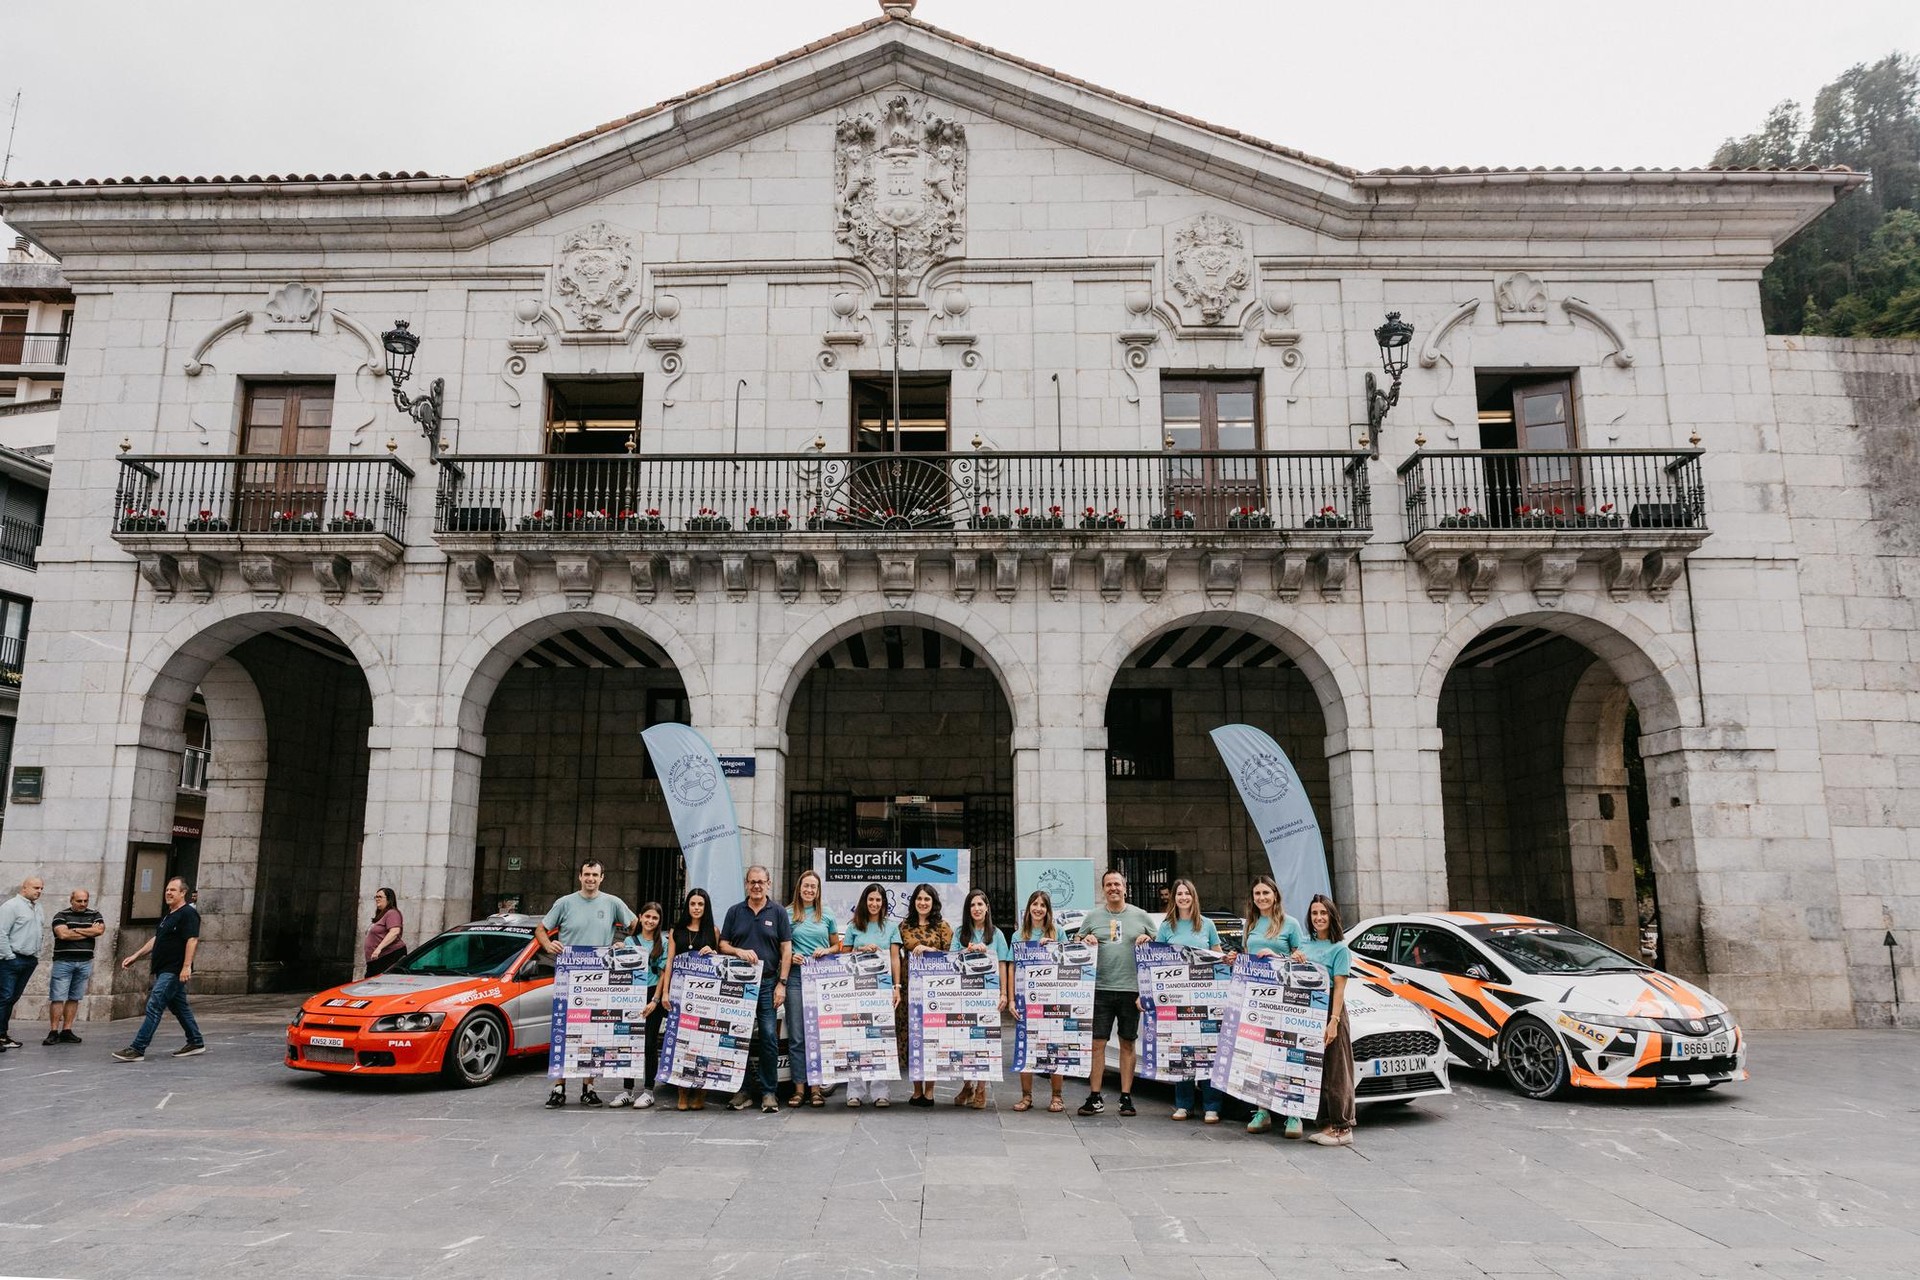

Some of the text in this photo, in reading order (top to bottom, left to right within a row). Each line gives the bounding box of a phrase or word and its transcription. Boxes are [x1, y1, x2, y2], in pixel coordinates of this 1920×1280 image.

[829, 850, 903, 868] idegrafik
[556, 956, 603, 965] RALLYSPRINTA
[1136, 952, 1183, 962] RALLYSPRINTA
[673, 961, 717, 975] RALLYSPRINTA
[909, 962, 954, 971] RALLYSPRINTA
[574, 972, 603, 982] TXG
[1029, 968, 1052, 978] TXG
[1156, 968, 1183, 979] TXG
[1234, 966, 1278, 980] RALLYSPRINTA
[822, 980, 848, 990] TXG
[928, 978, 955, 987] TXG
[1251, 988, 1278, 996] TXG
[1285, 991, 1310, 1000] idegrafik
[1259, 1002, 1307, 1014] DANOBATGROUP
[1285, 1016, 1322, 1030] DOMUSA
[1576, 1024, 1605, 1042] RAC
[1684, 1042, 1727, 1054] 8669 LCG
[1382, 1058, 1427, 1074] 3133 LXM
